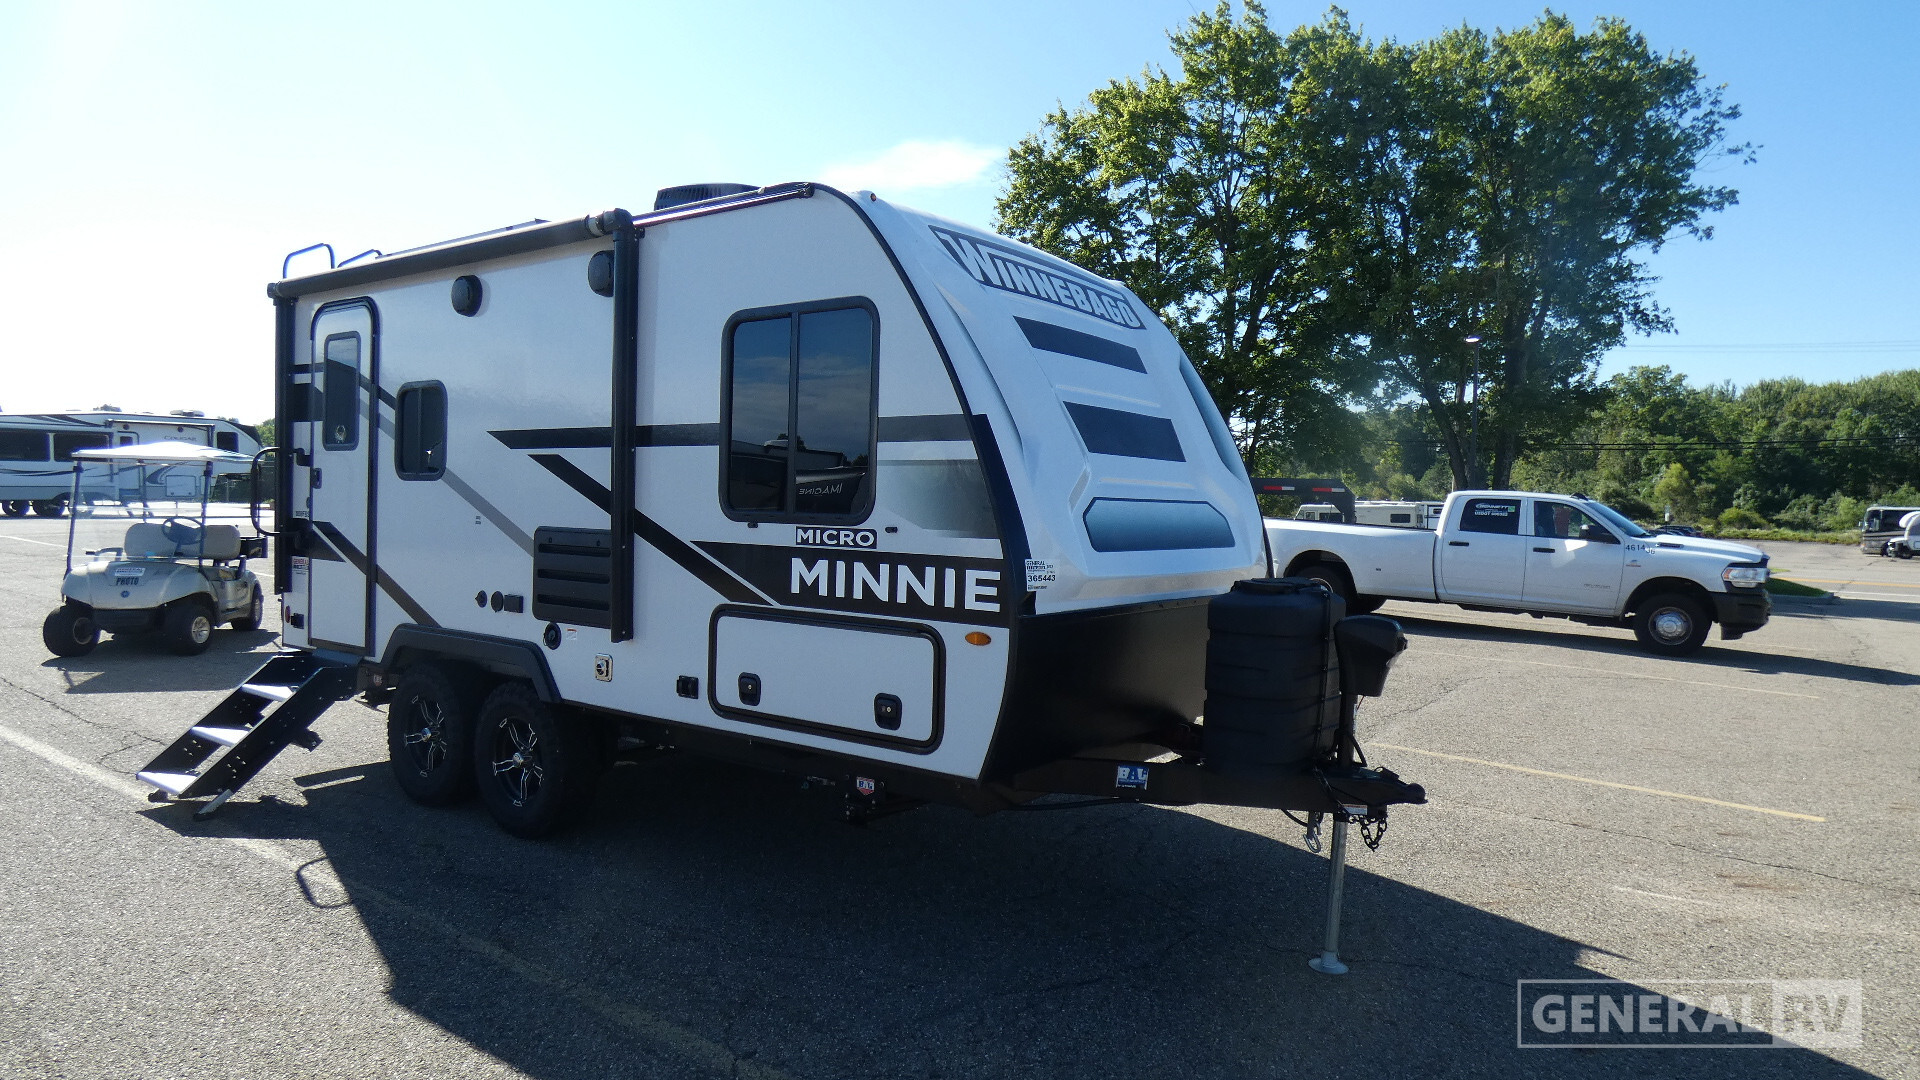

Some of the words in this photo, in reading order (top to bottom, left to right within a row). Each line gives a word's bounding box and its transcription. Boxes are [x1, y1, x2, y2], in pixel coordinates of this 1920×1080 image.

[933, 229, 1142, 328] WINNEBAGO
[796, 528, 875, 547] MICRO
[116, 577, 139, 585] PHOTO
[790, 557, 1001, 613] MINNIE
[1027, 574, 1056, 582] 365443
